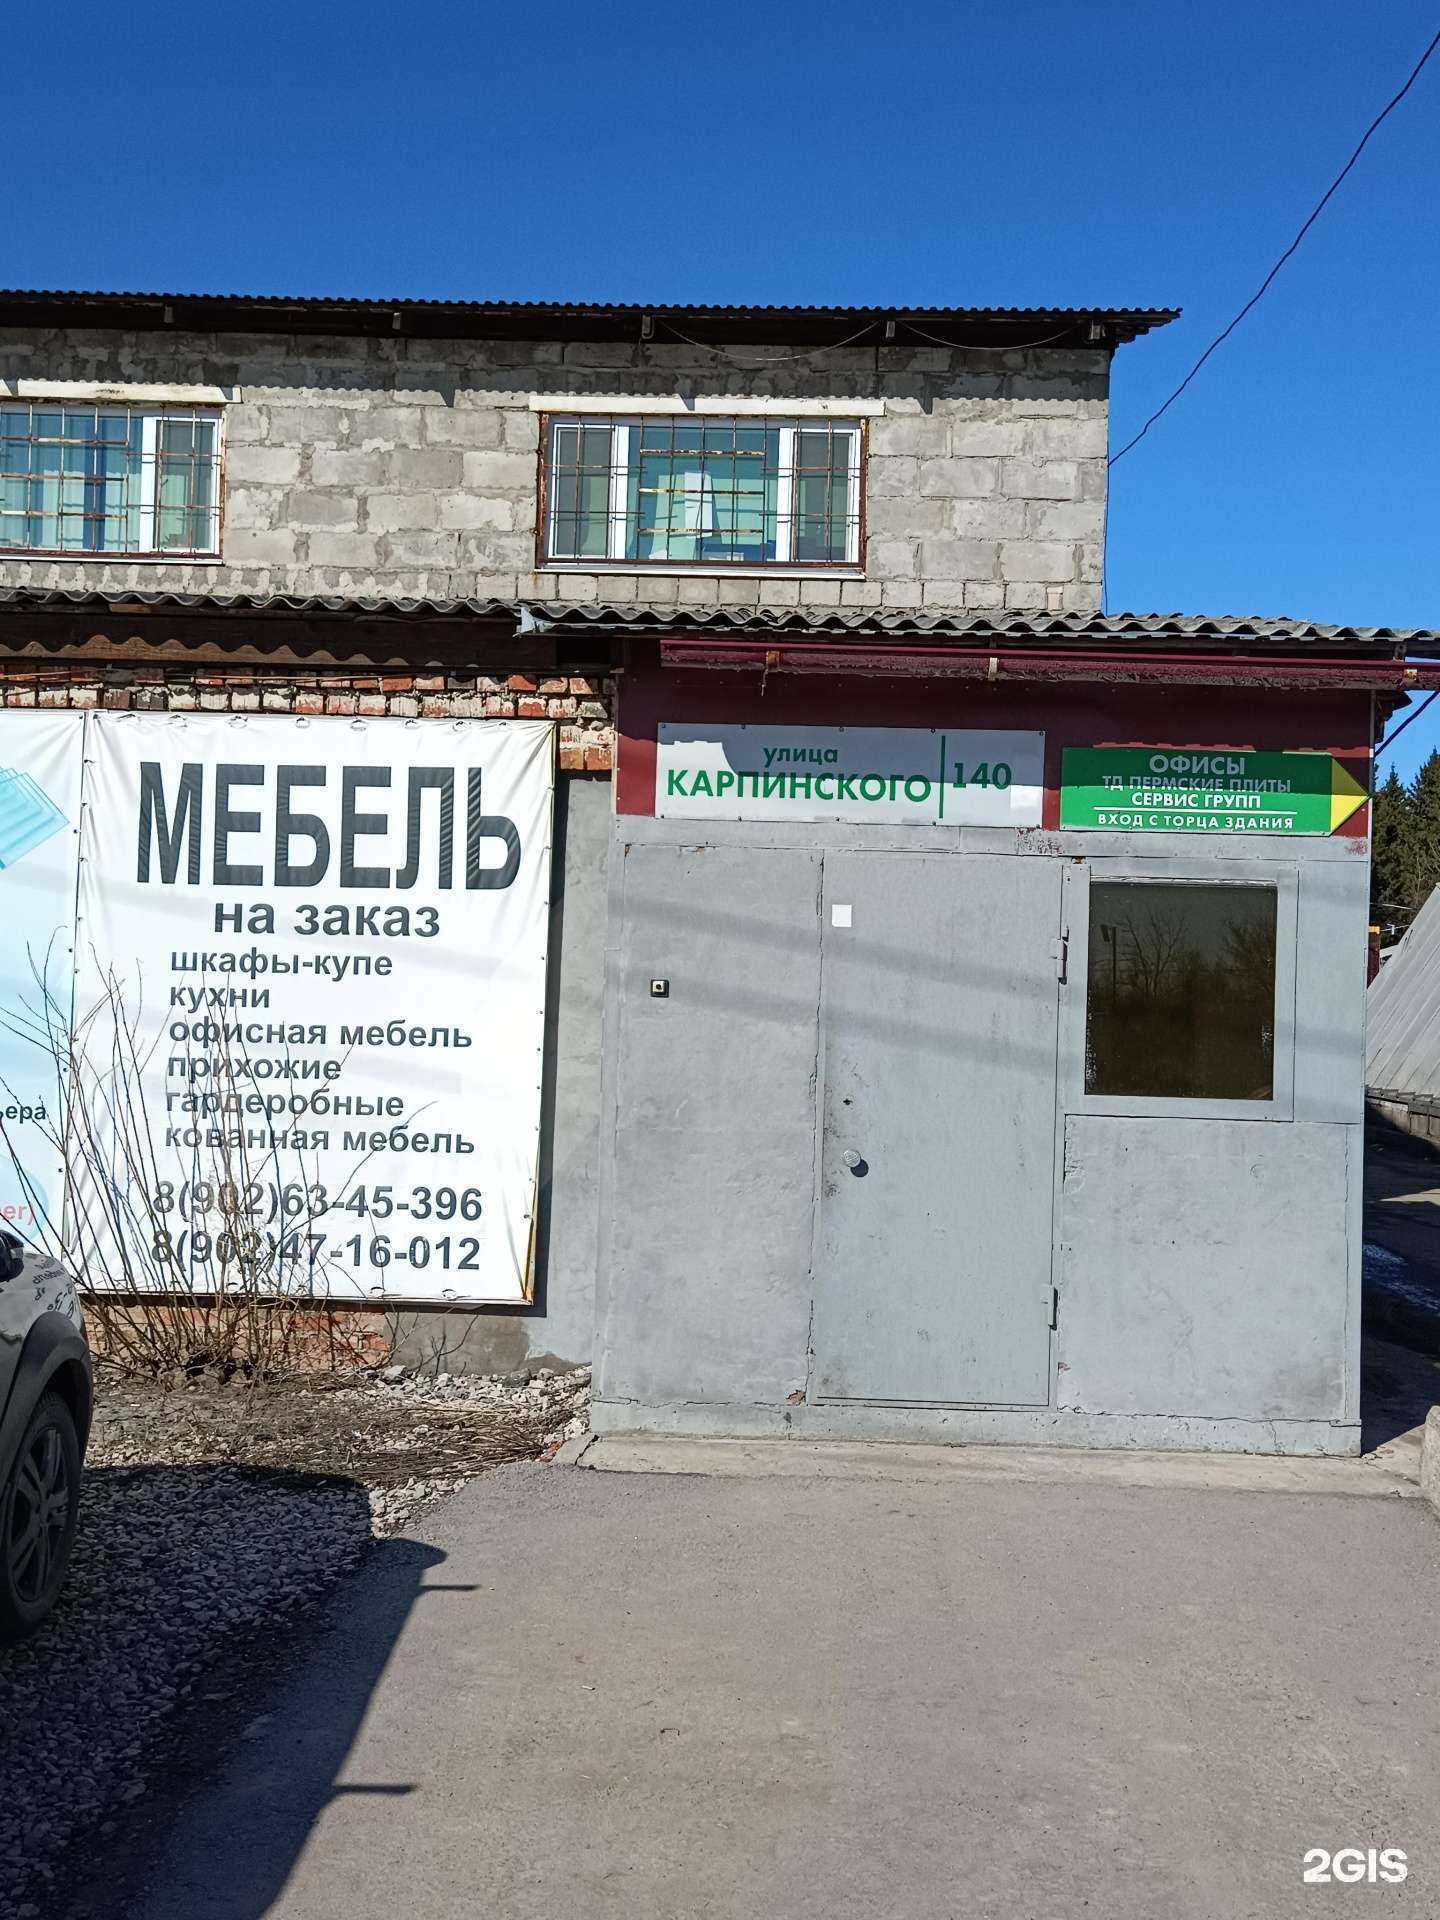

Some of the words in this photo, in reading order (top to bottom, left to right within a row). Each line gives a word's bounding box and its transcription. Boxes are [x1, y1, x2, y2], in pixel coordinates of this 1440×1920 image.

[763, 745, 839, 768] улица
[1149, 754, 1246, 776] ОФИСЫ
[667, 768, 932, 803] КАРПИНСКОГО
[953, 761, 1013, 790] 140
[1102, 775, 1124, 791] ТД
[1129, 775, 1224, 793] ПЕРМСКИЕ
[1229, 778, 1292, 794] ПЛИТЫ
[1131, 791, 1199, 808] СЕРВИС
[1204, 793, 1261, 809] ГРУПП
[137, 761, 523, 891] МЕБЕЛЬ
[1098, 813, 1143, 827] ВХОД
[1149, 815, 1158, 826] С
[1164, 814, 1218, 830] ТОРЦА
[1224, 815, 1293, 830] ЗДАНИЯ
[214, 902, 275, 934] на
[293, 903, 440, 937] заказ
[171, 946, 393, 982] шкафы-купе
[169, 985, 270, 1013] кухни
[169, 1015, 327, 1049] офисная
[340, 1019, 473, 1048] мебель
[168, 1056, 342, 1084] прихожие
[0, 1105, 46, 1124] ера
[166, 1088, 404, 1120] гардеробные
[165, 1126, 329, 1150] кованная
[343, 1125, 475, 1154] мебель
[0, 1202, 35, 1226] er)
[153, 1180, 483, 1224] 8(902)63-45-396
